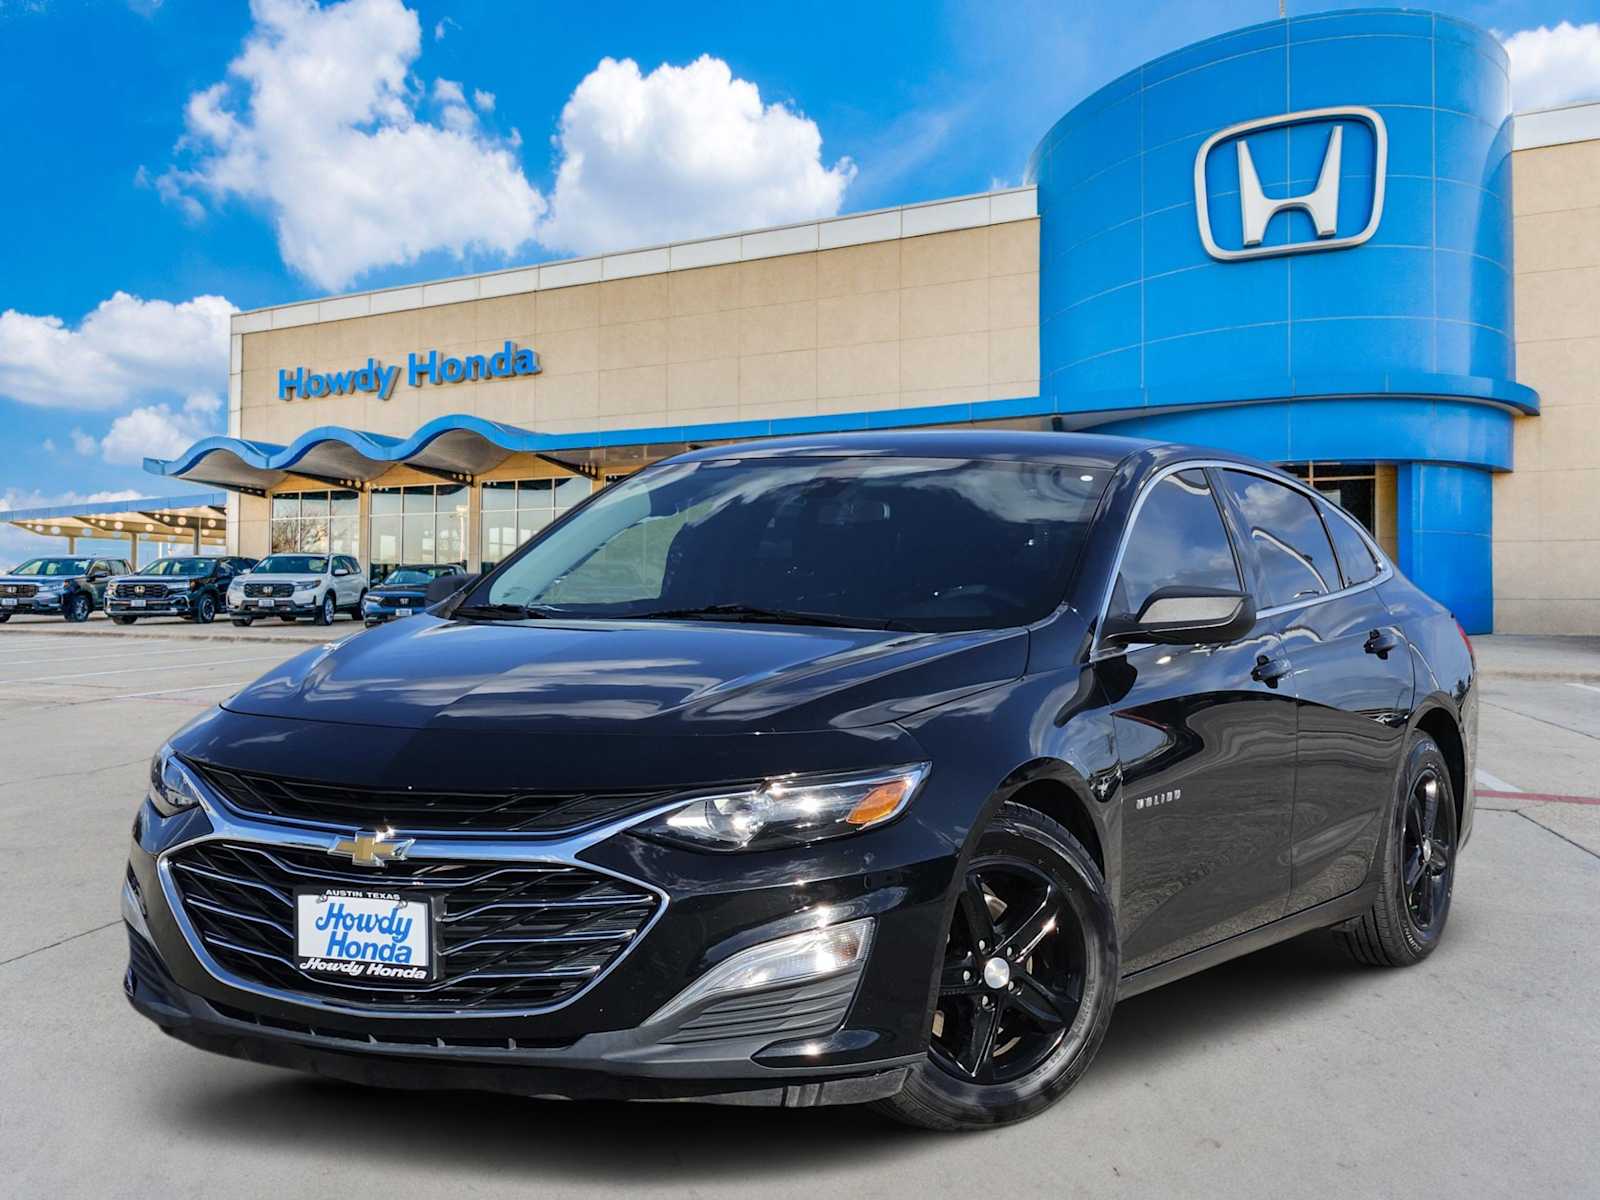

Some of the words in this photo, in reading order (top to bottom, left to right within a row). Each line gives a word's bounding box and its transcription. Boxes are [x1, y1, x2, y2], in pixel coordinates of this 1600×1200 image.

[278, 358, 401, 400] Howdy
[408, 341, 542, 387] Honda
[325, 889, 363, 898] AUSTIN
[366, 892, 401, 900] TEXAS
[315, 902, 413, 943] Howdy
[325, 931, 413, 964] Honda
[299, 957, 365, 976] Howdy
[366, 964, 427, 980] Honda
